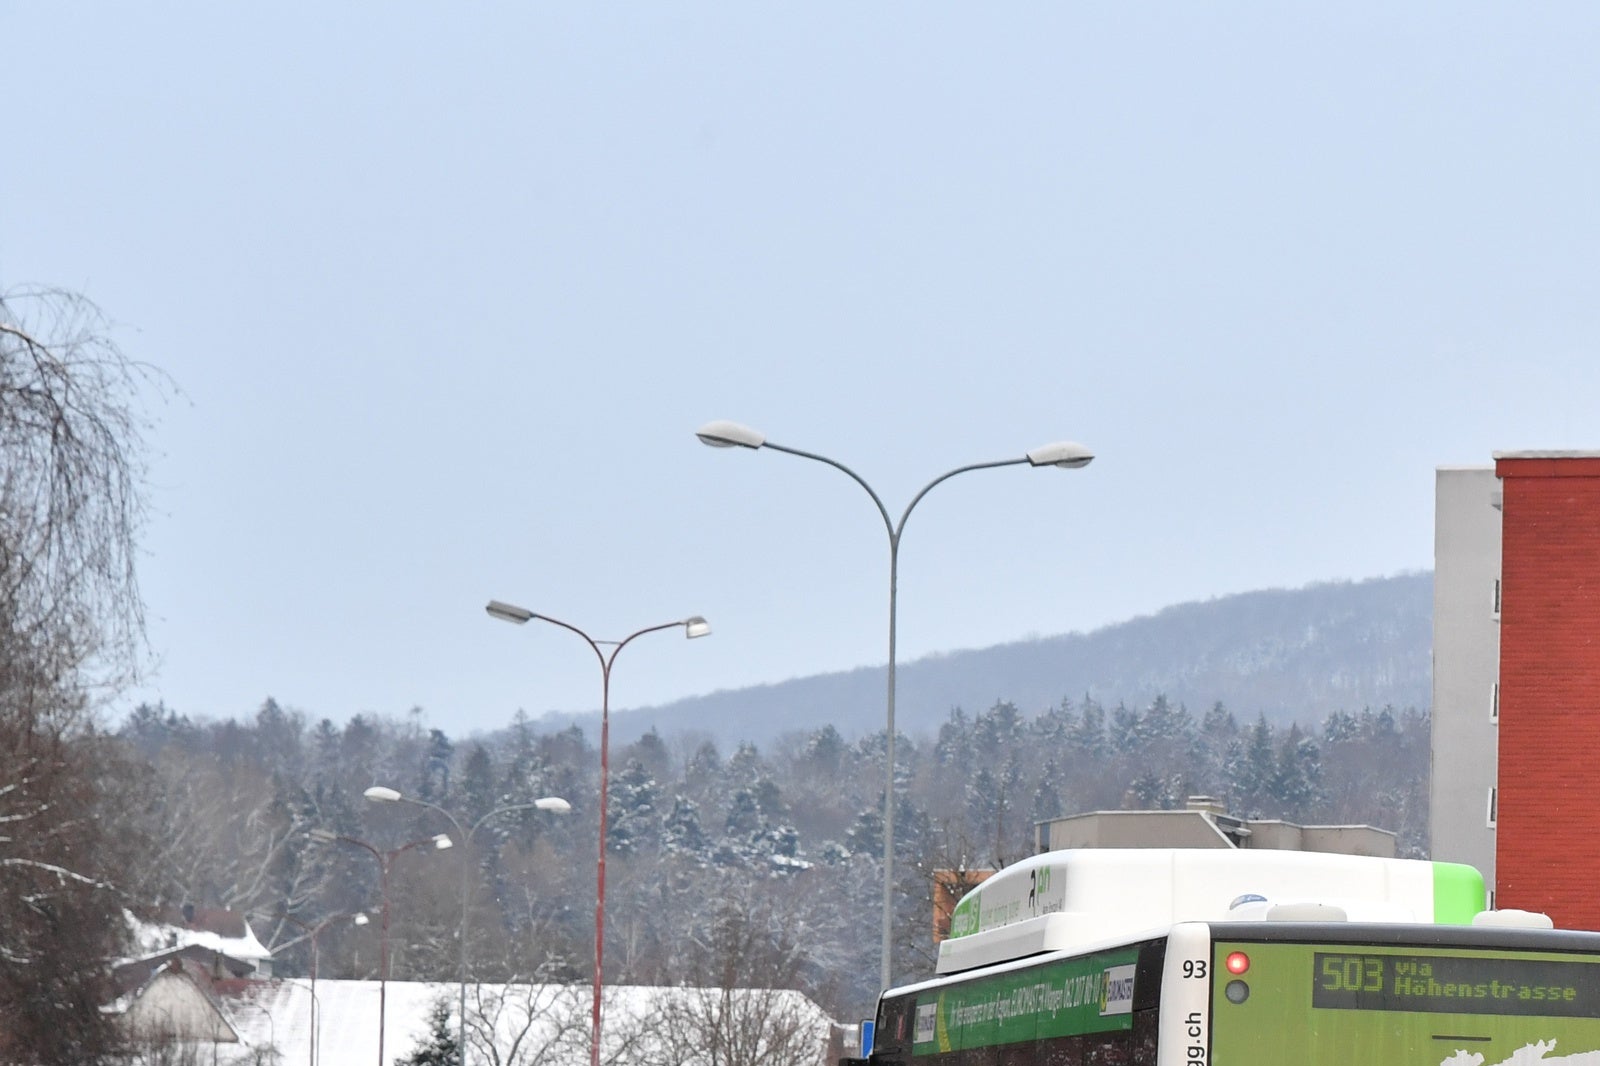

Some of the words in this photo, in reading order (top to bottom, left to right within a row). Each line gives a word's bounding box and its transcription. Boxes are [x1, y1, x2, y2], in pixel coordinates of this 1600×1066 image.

[1183, 960, 1207, 978] 93
[1322, 957, 1383, 992] 503
[1395, 959, 1432, 976] via
[1394, 976, 1577, 1001] Höhenstrasse
